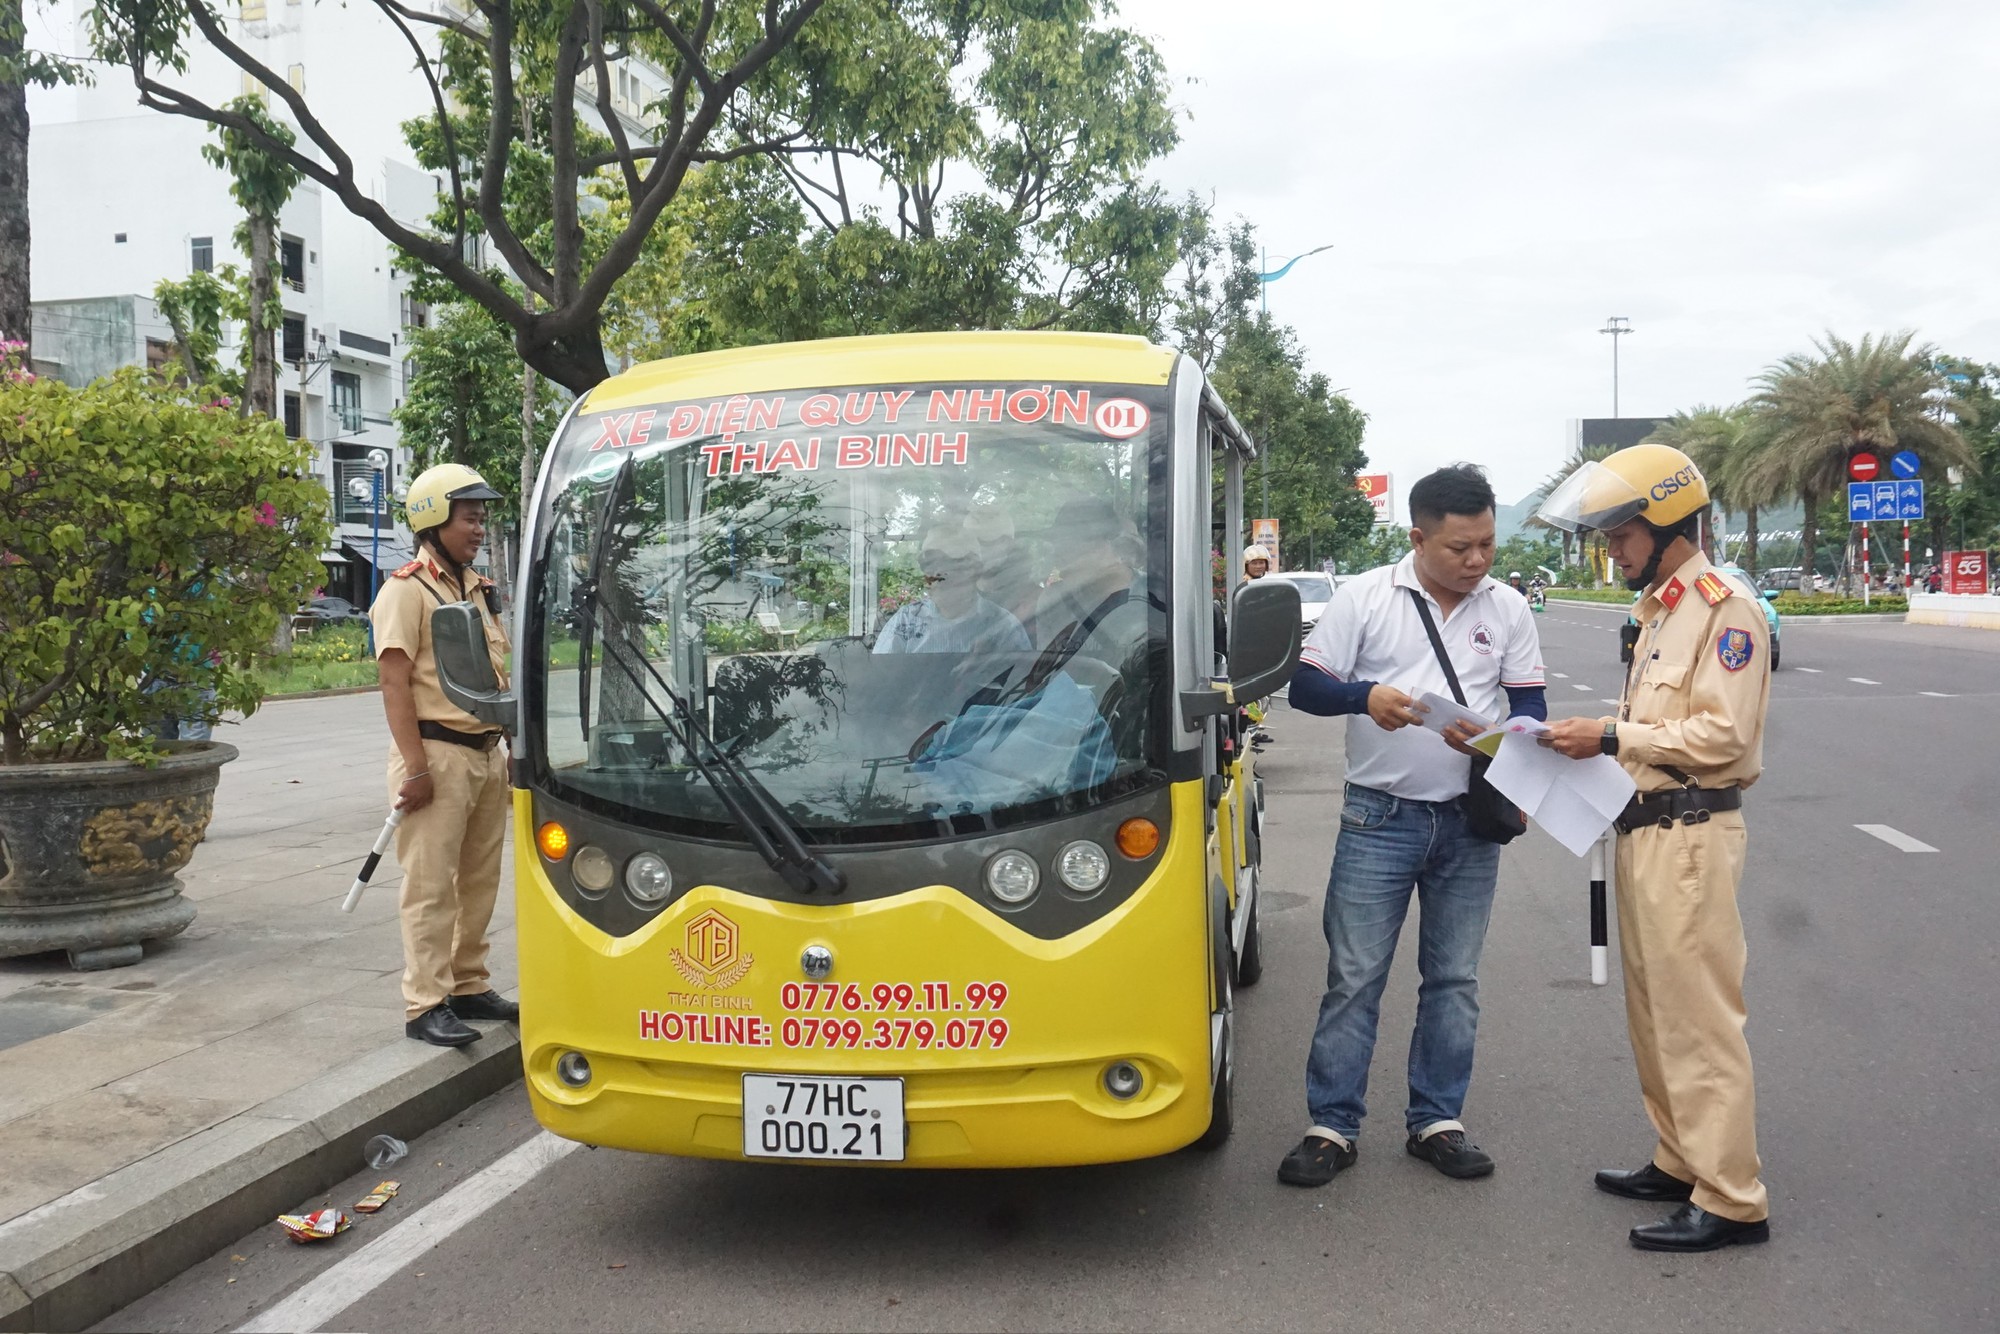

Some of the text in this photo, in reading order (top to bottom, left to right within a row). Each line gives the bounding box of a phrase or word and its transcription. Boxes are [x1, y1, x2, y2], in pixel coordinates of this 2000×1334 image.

[588, 385, 1139, 452] XE ĐIỆN QUY NHƠN 01
[700, 432, 968, 477] THAI BINH
[1650, 464, 1697, 501] CSGT
[408, 496, 434, 517] SGT
[1957, 560, 1982, 575] 5G
[667, 992, 753, 1011] THAI BINH
[780, 981, 1010, 1013] 0776.99.11.99
[639, 1010, 1010, 1050] HOTLINE: 0799.379.079
[775, 1080, 869, 1117] 77HC
[761, 1118, 883, 1157] 000.21
